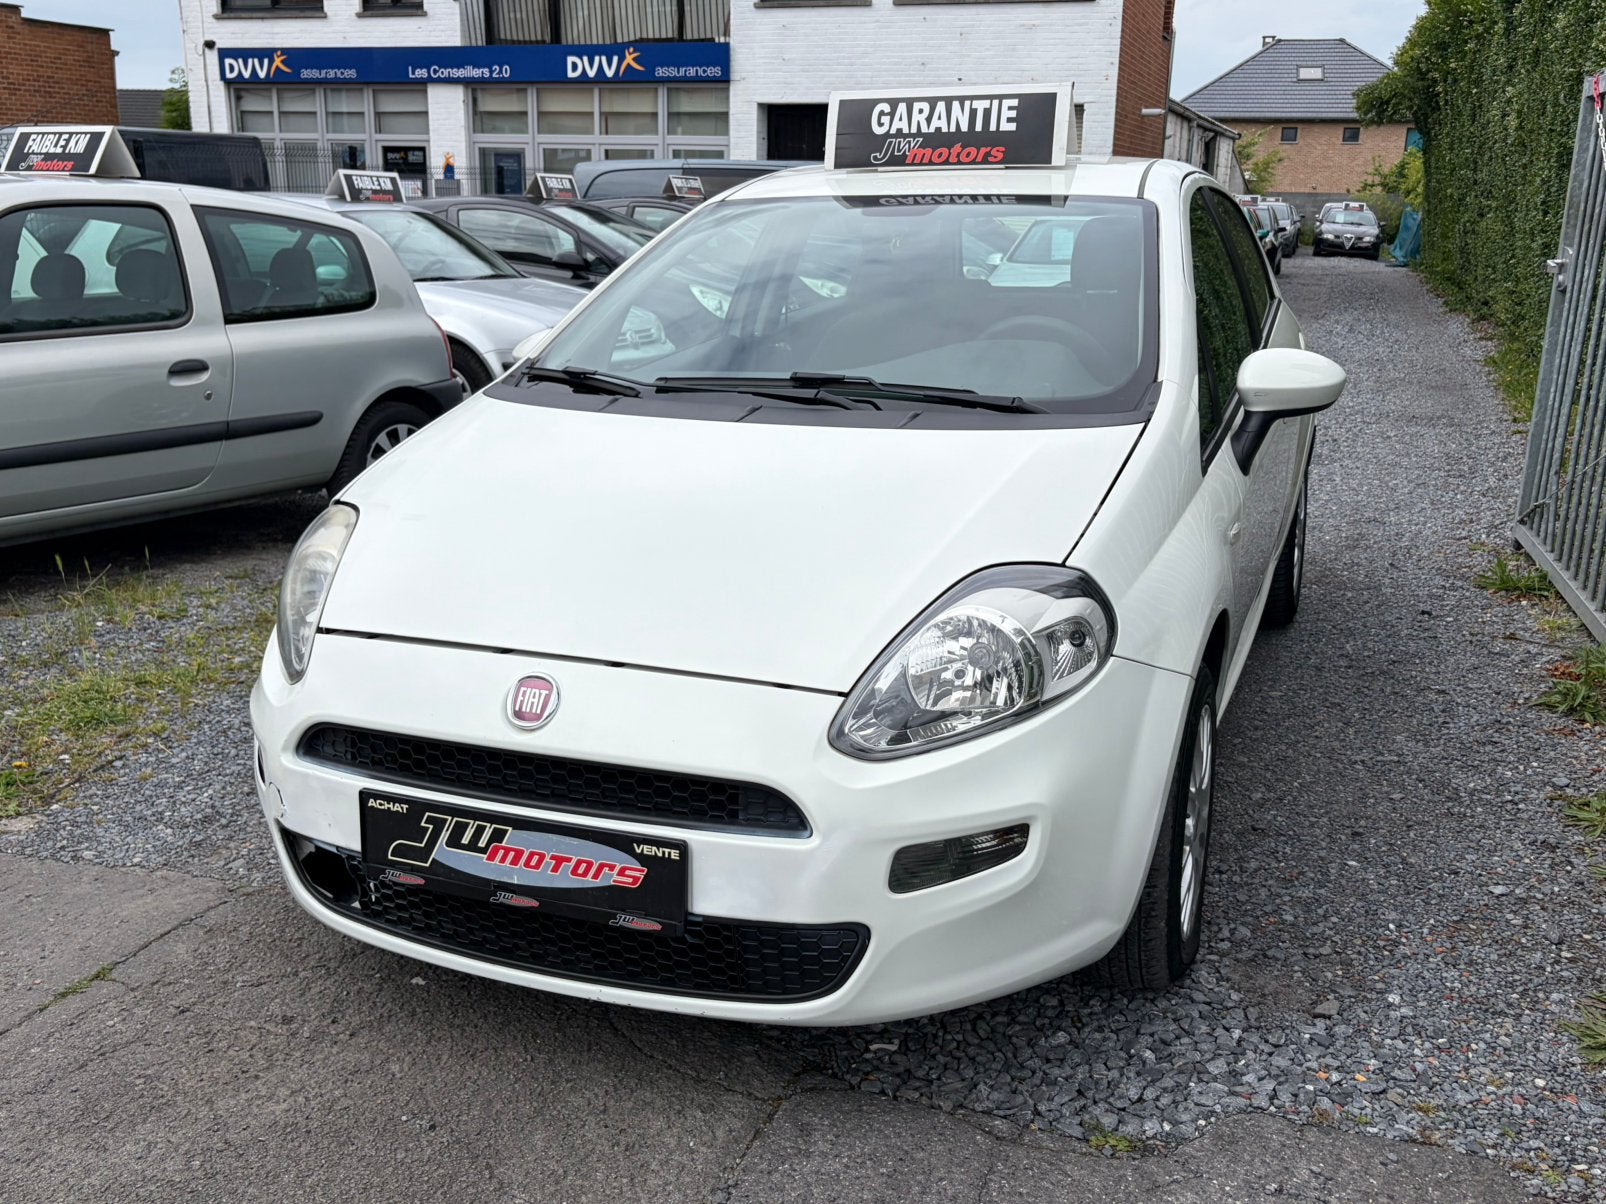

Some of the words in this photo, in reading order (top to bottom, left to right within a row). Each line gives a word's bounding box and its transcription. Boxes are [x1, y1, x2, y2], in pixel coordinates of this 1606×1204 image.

[224, 57, 270, 79] DVV
[300, 67, 357, 79] assurances
[408, 65, 428, 78] Les
[430, 65, 490, 78] Conseillers
[492, 65, 510, 78] 2.0
[566, 55, 619, 78] DVV
[655, 66, 722, 77] assurances
[871, 98, 1019, 136] GARANTIE
[24, 133, 70, 153] FAIBLE
[65, 133, 91, 153] KM
[871, 138, 922, 164] JW
[906, 142, 1006, 164] motors
[32, 158, 75, 170] motors
[352, 175, 381, 190] FAIBLE
[379, 177, 393, 190] KM
[515, 686, 549, 714] FIAT
[368, 798, 408, 814] ACHAT
[388, 812, 512, 867] JW
[633, 843, 680, 860] VENTE
